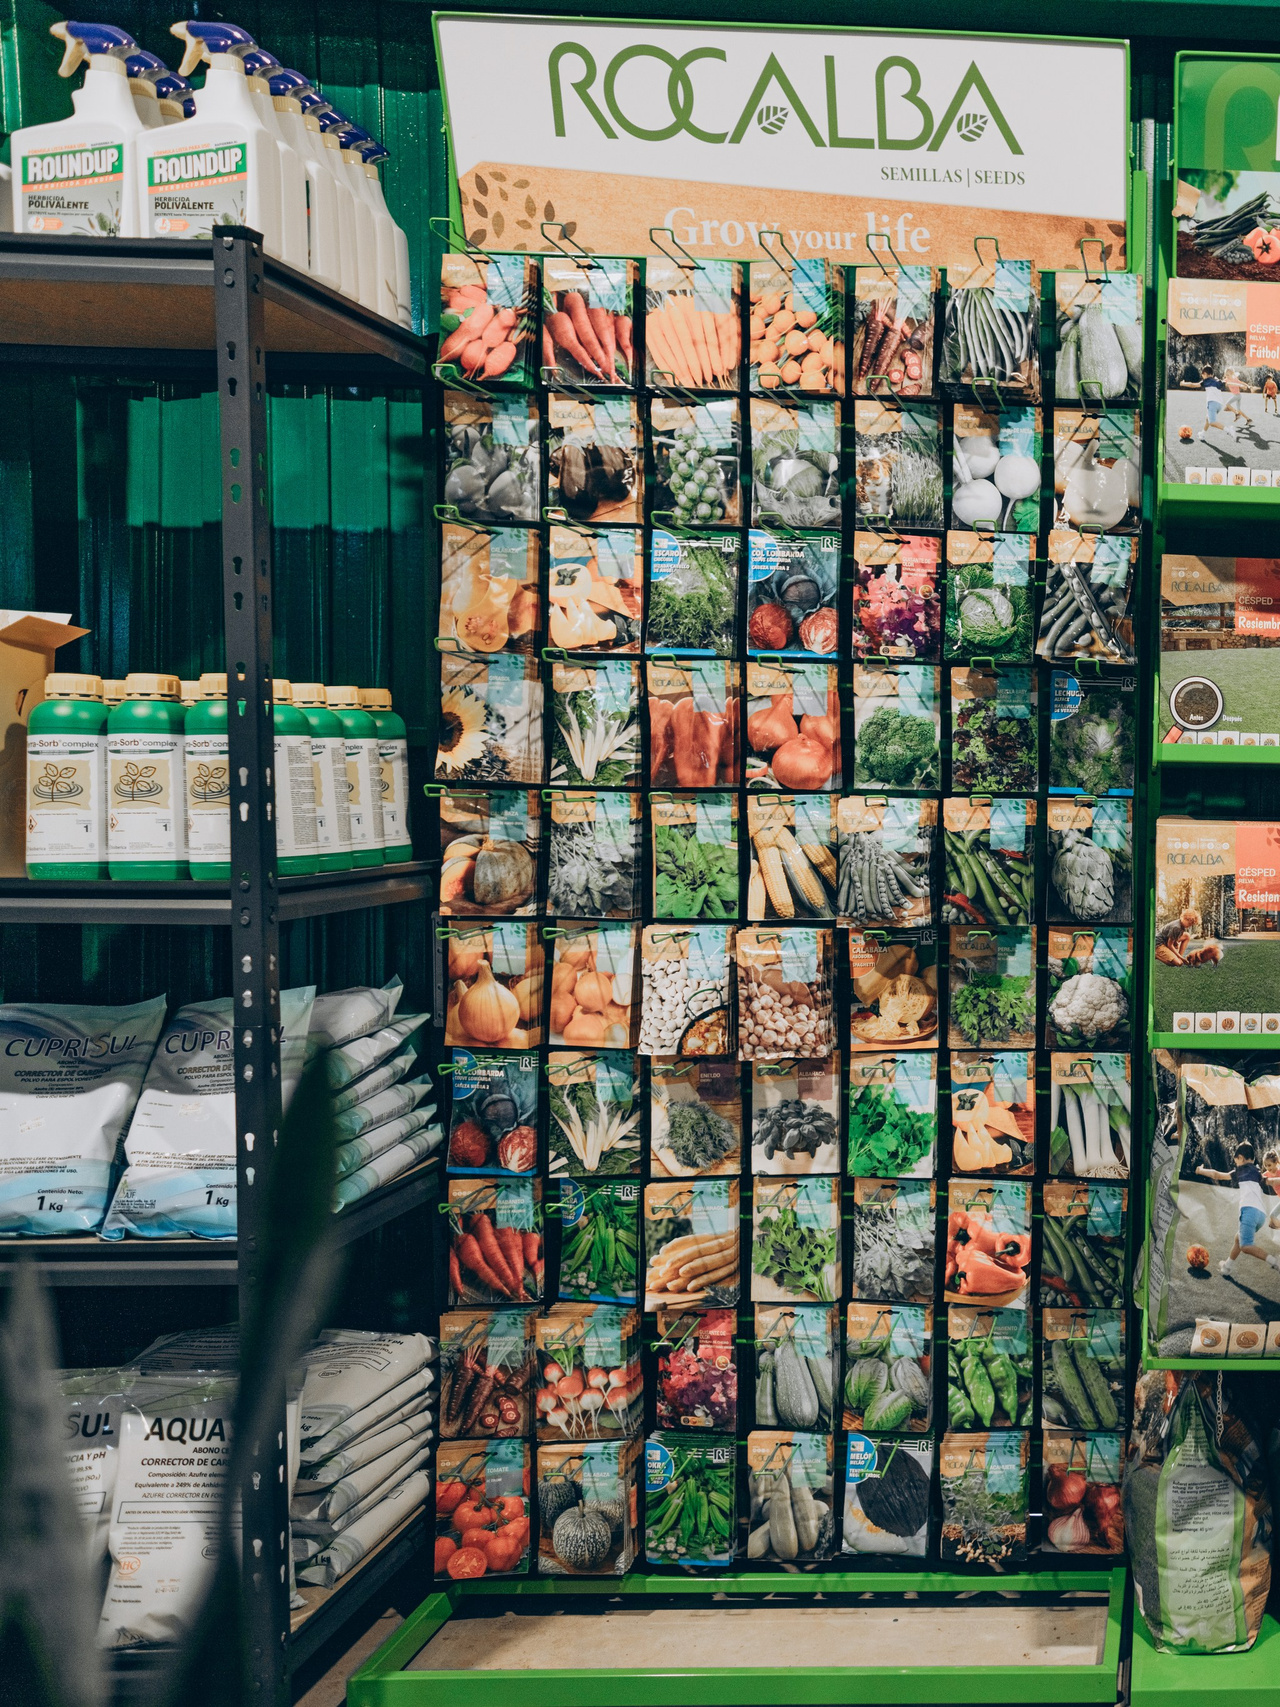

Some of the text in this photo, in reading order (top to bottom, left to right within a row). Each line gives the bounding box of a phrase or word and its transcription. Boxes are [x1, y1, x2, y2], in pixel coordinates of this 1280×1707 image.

[548, 40, 1025, 155] ROCALBA
[28, 148, 119, 182] ROUNDUP
[154, 148, 242, 183] ROUNDUP
[881, 165, 1026, 186] SEMILLAS SEEDS
[28, 201, 89, 210] POLIVALENTE
[154, 202, 214, 210] POLIVALENTE
[664, 206, 931, 256] Grow your life
[1180, 308, 1237, 321] ROCALBA
[1250, 345, 1280, 359] Fútbol
[1058, 426, 1094, 435] ROCALBA
[654, 550, 688, 558] ESCAROLA
[751, 550, 805, 559] COL LOMBARDA
[1171, 581, 1225, 593] ROCALBA
[1238, 595, 1273, 605] CÉSPED
[752, 680, 787, 689] ROCALBA
[1055, 690, 1085, 698] LECHUGA
[1189, 714, 1243, 723] Antes Después
[62, 741, 99, 750] complex
[143, 740, 178, 749] complex
[1052, 815, 1087, 823] ROCALBA
[1167, 853, 1225, 865] ROCALBA
[1238, 867, 1276, 877] CÉSPED
[852, 946, 888, 955] CALABAZA
[956, 942, 992, 952] ROCALBA
[177, 1065, 220, 1075] CORRECTOR
[205, 1190, 229, 1207] 1 Kg
[38, 1195, 63, 1213] 1 Kg
[144, 1418, 226, 1445] AQUA
[93, 1451, 106, 1461] pH
[193, 1447, 220, 1455] ABONO
[141, 1458, 208, 1468] CORRECTOR DE
[135, 1482, 170, 1490] Equivalente
